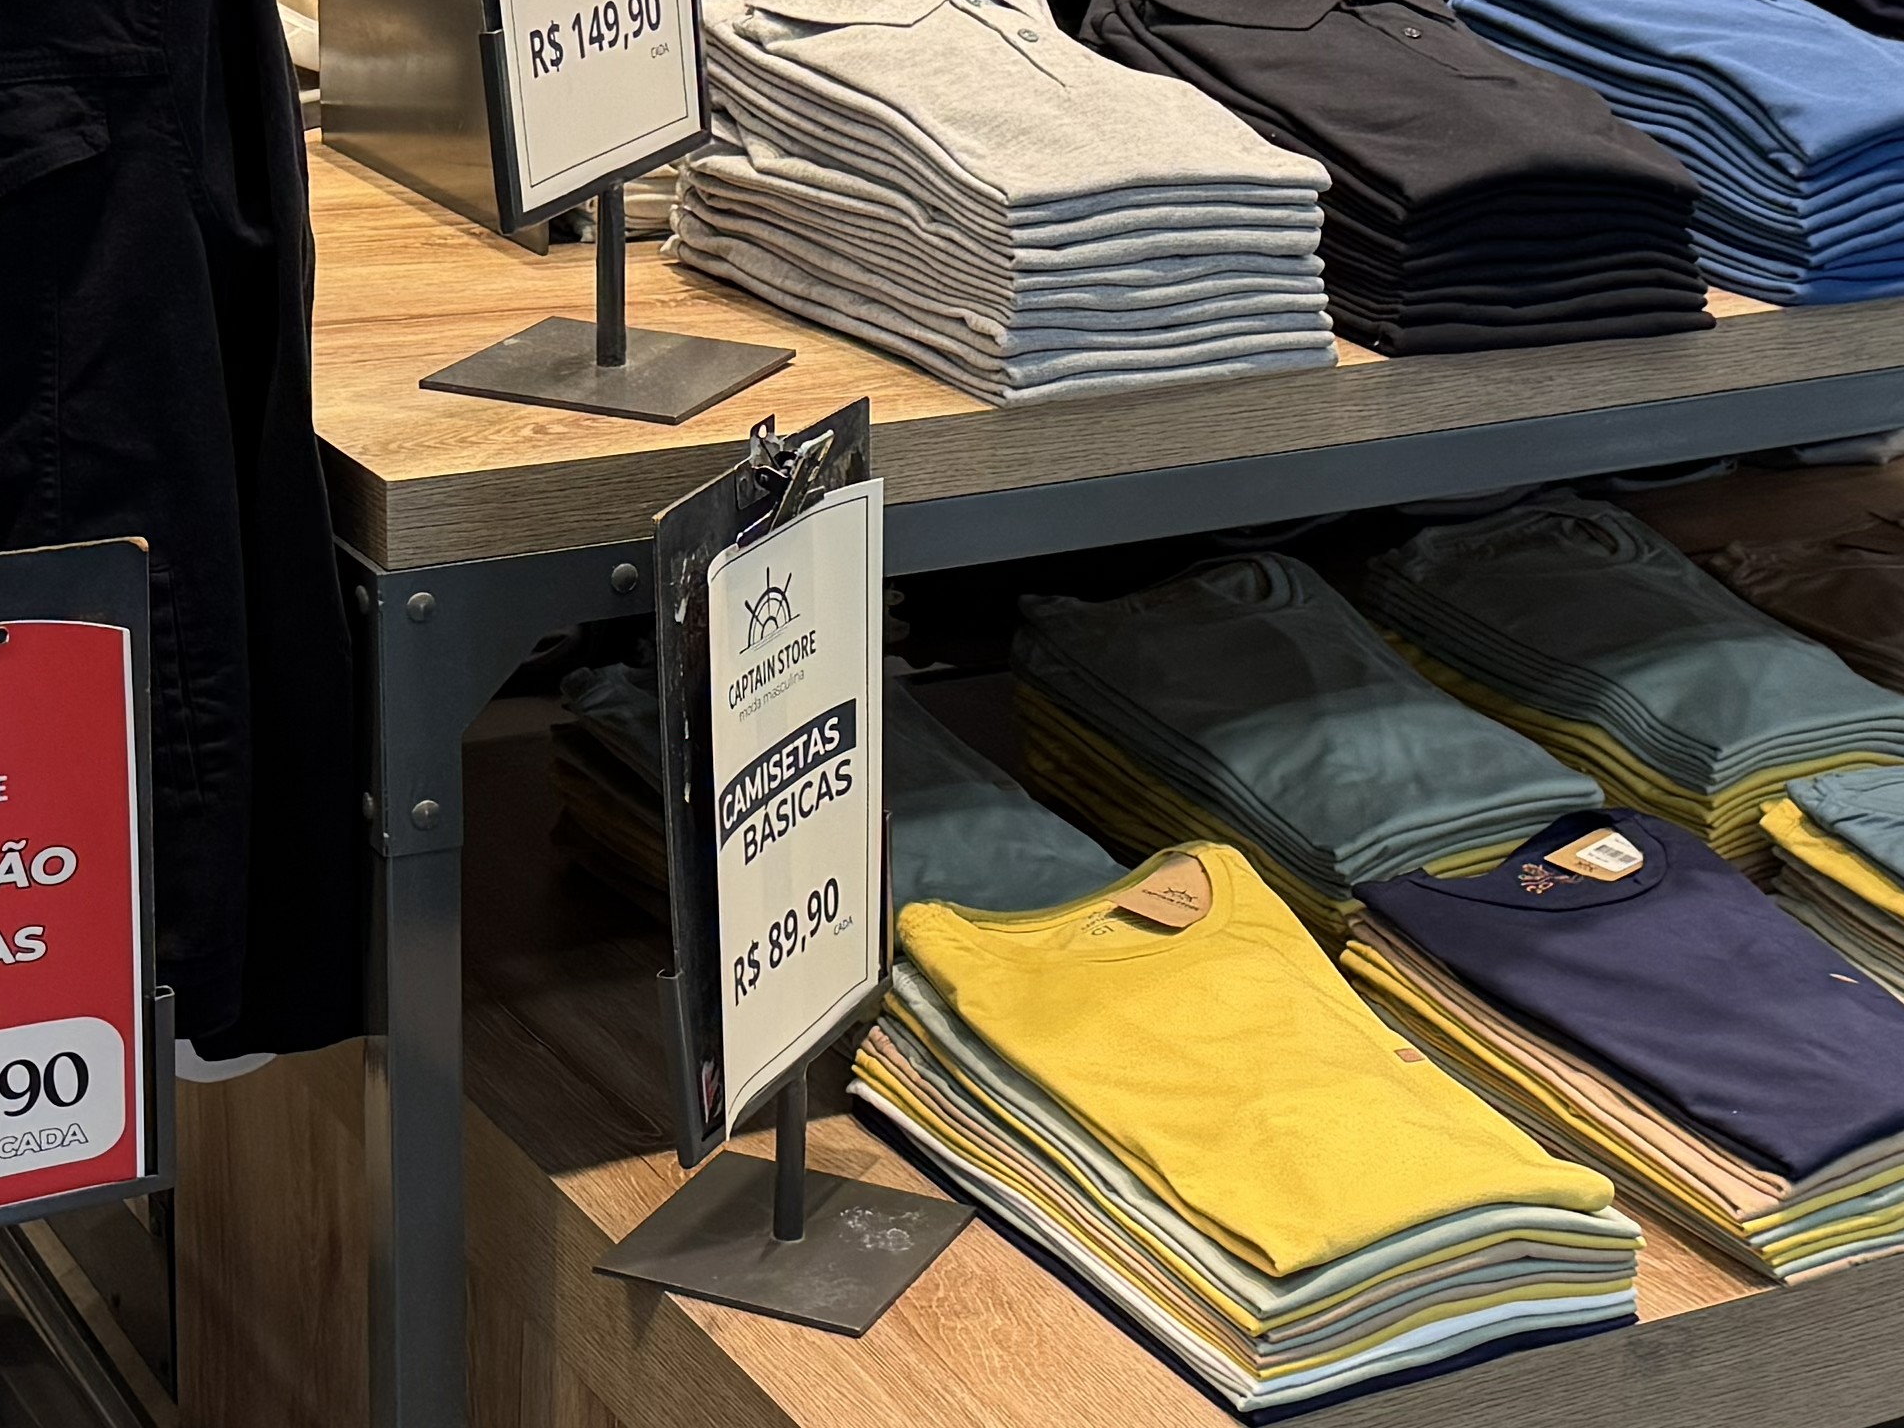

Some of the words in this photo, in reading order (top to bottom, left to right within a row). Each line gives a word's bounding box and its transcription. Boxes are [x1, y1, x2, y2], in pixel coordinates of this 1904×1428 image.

[529, 19, 564, 79] R$
[728, 655, 775, 710] CAPTAIN
[778, 629, 817, 675] STORE
[739, 699, 762, 723] moda
[763, 669, 806, 705] masculina
[722, 716, 841, 830] CAMISETAS
[743, 758, 853, 866] BÁSICAS
[733, 939, 761, 1007] R$
[768, 877, 840, 970] 89,90
[833, 915, 854, 936] CADA
